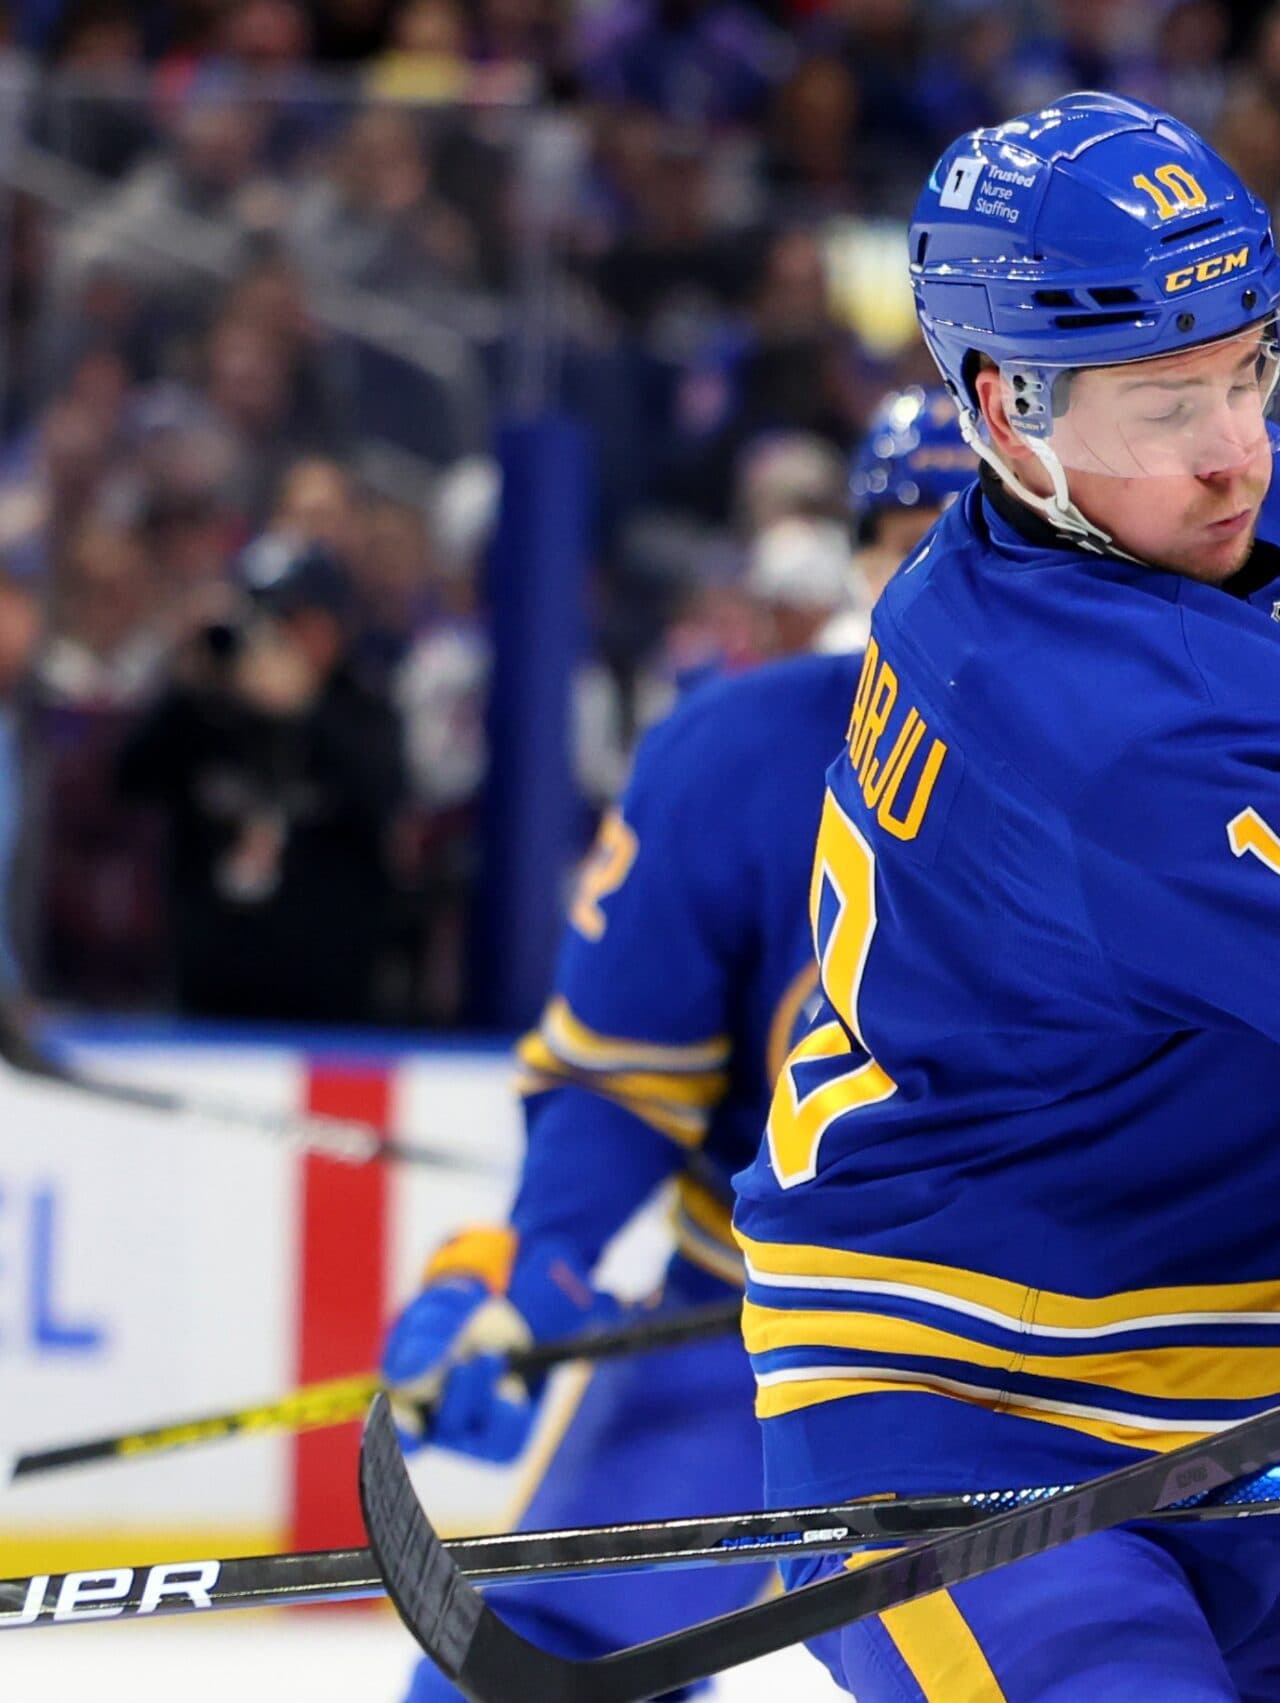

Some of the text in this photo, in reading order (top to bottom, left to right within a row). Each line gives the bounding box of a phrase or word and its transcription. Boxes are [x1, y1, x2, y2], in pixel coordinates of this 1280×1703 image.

[987, 164, 1036, 188] Trusted
[980, 180, 1014, 200] Nurse
[1132, 164, 1208, 220] 10
[975, 197, 1020, 224] Staffing
[1164, 246, 1250, 293] CCM
